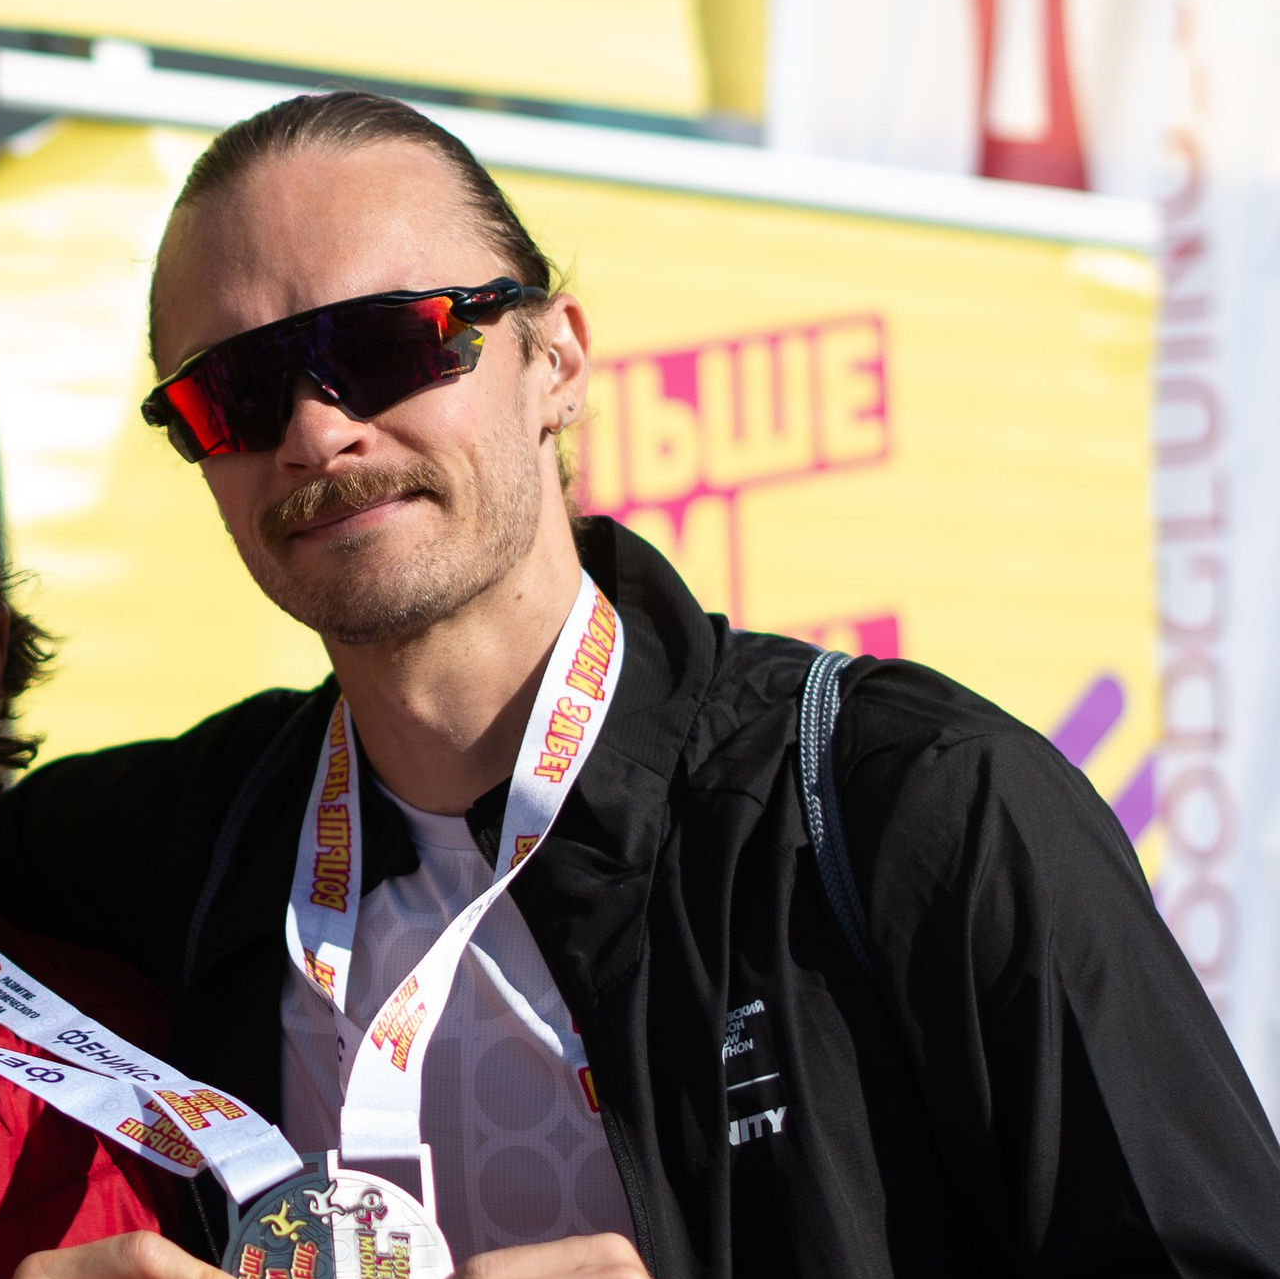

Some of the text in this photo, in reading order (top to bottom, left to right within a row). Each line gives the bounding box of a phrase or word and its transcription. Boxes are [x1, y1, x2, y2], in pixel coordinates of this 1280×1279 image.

[534, 696, 591, 783] ЗАБЕГ
[321, 747, 350, 802] ЧЕМ
[310, 803, 352, 913] БОЛЬШЕ
[0, 976, 36, 1001] РАЗВИТИЕ
[52, 1029, 161, 1084] ФЕНИКС
